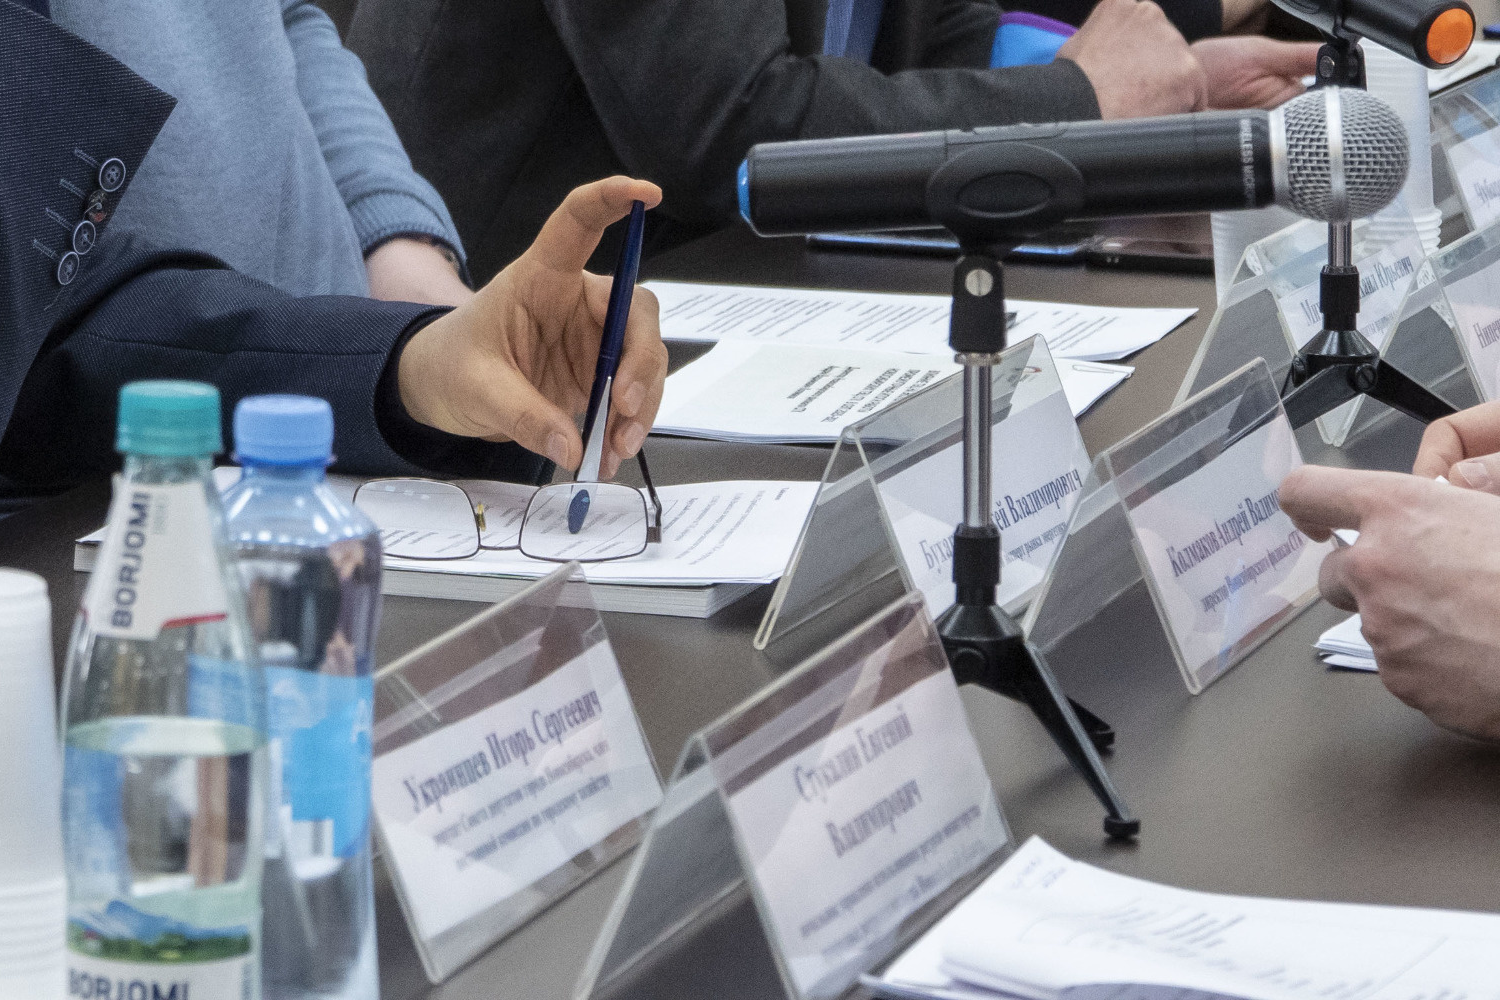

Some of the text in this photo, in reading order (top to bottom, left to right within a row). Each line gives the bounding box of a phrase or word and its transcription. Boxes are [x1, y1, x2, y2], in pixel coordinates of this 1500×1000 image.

[1373, 256, 1414, 291] Юрьевич
[1004, 468, 1084, 524] Владимирович
[1166, 488, 1281, 578] Колмаков Андрей Вадим
[110, 490, 151, 629] BORJOMI
[485, 731, 536, 767] Игорь
[530, 689, 603, 744] Сергеевич
